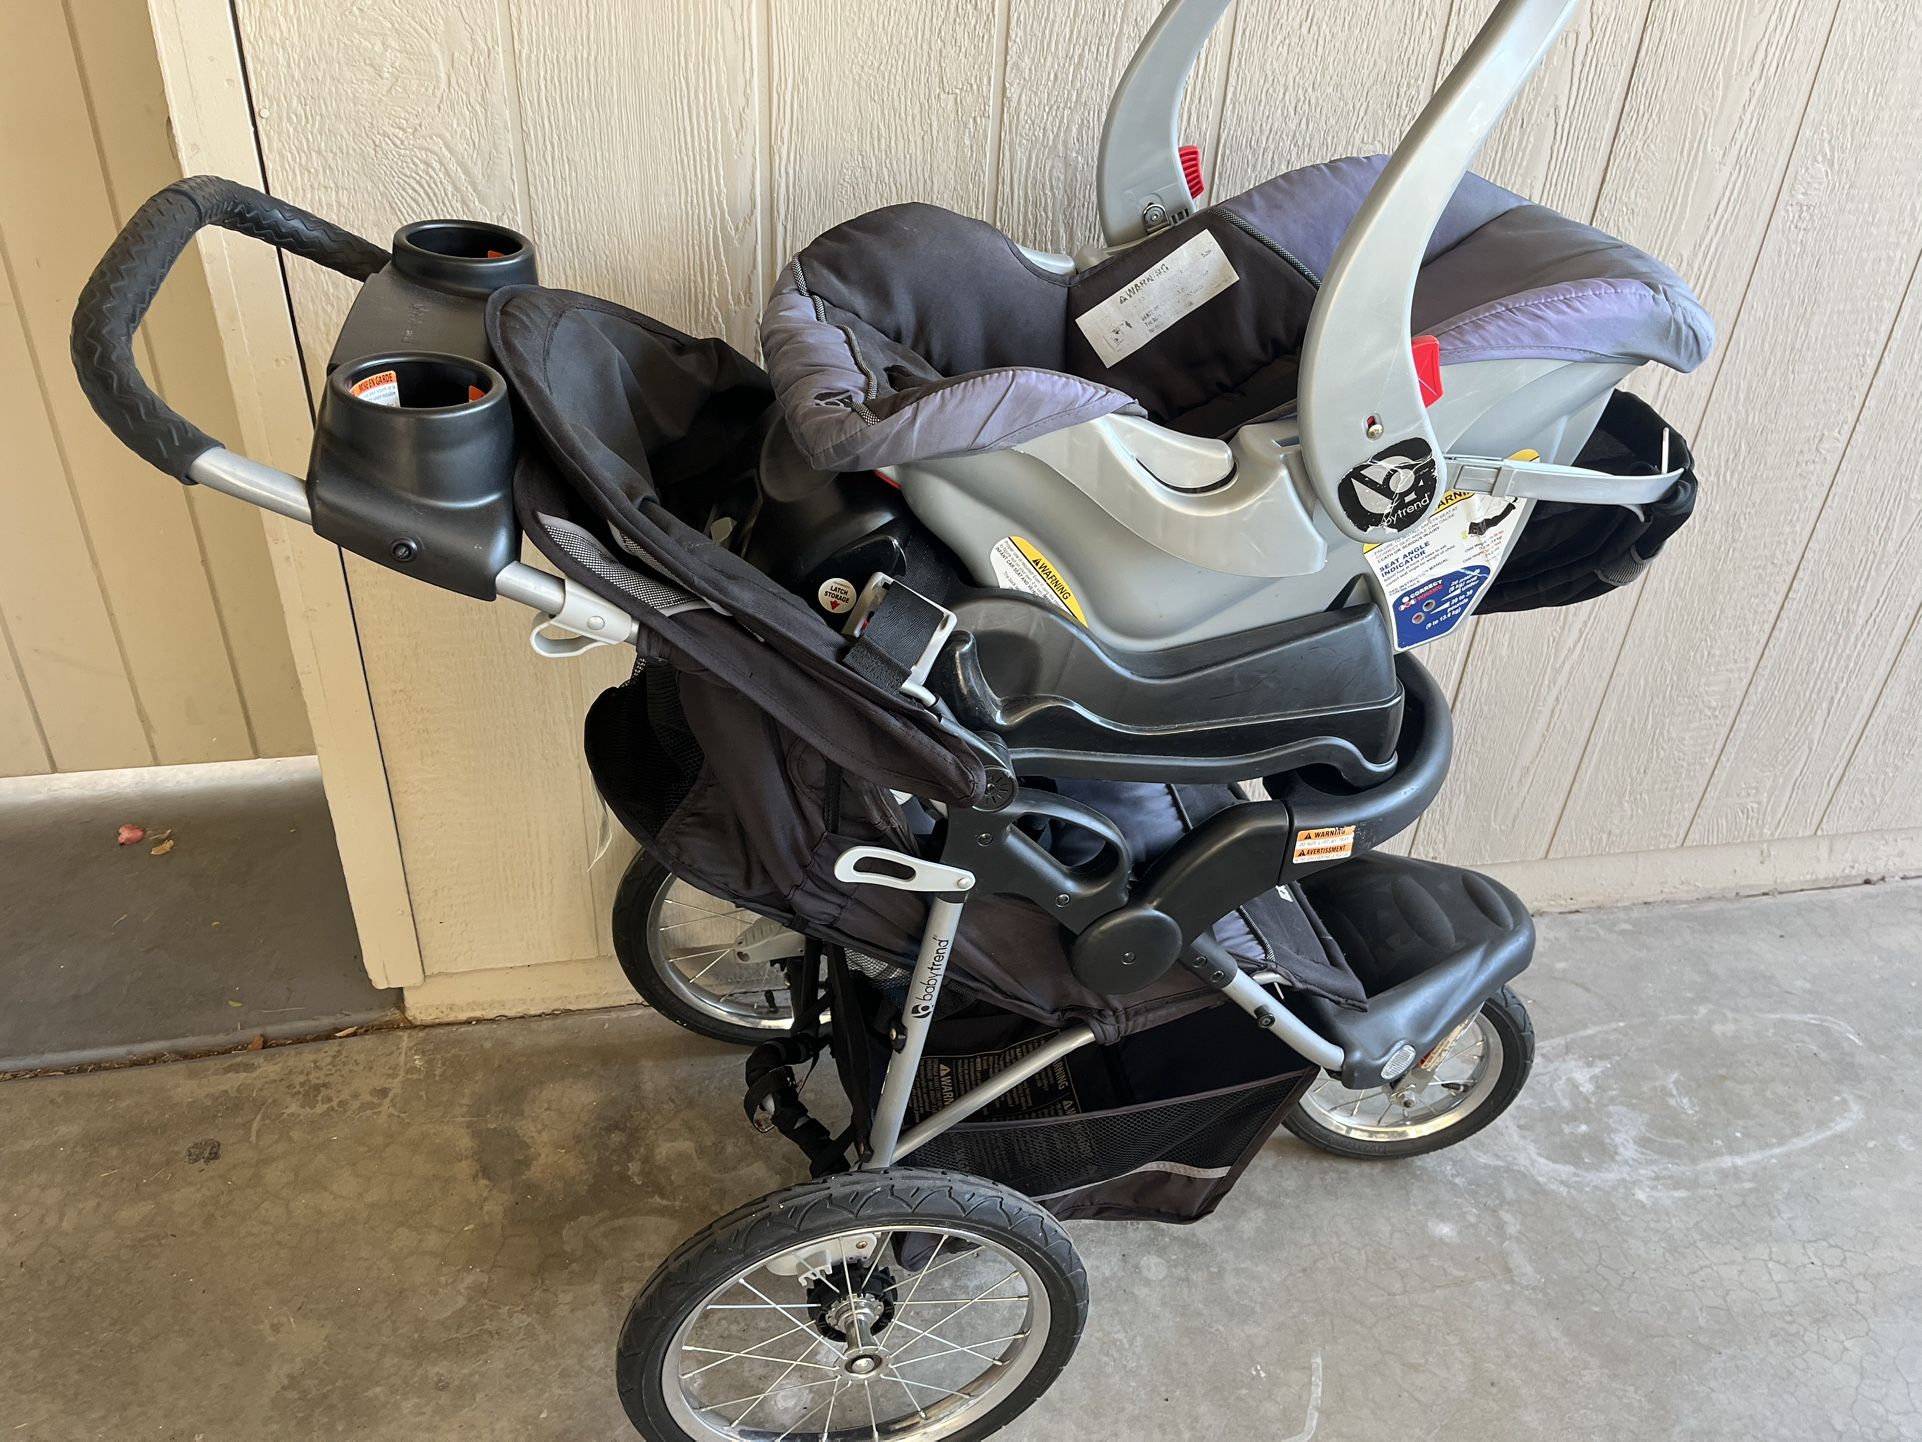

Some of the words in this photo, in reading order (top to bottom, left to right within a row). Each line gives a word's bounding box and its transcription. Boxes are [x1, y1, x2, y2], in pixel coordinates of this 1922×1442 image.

[375, 373, 393, 385] GARDE
[1379, 557, 1401, 572] SEAT
[1402, 541, 1430, 559] ANGLE
[1381, 550, 1426, 577] INDICATOR
[995, 547, 1008, 560] INFANT
[1006, 560, 1014, 568] CAR
[1013, 567, 1022, 578] SEAT
[1021, 577, 1029, 585] AND
[830, 585, 849, 596] LATCH
[1038, 563, 1071, 600] WARNING
[1410, 579, 1443, 599] CORRECT
[1461, 580, 1479, 591] under
[824, 591, 850, 603] STORAGE
[1417, 585, 1443, 601] WRONG
[1447, 598, 1469, 613] pounds
[1452, 607, 1462, 615] kg)
[915, 939, 949, 1001] babytrend
[941, 1076, 954, 1105] WARN
